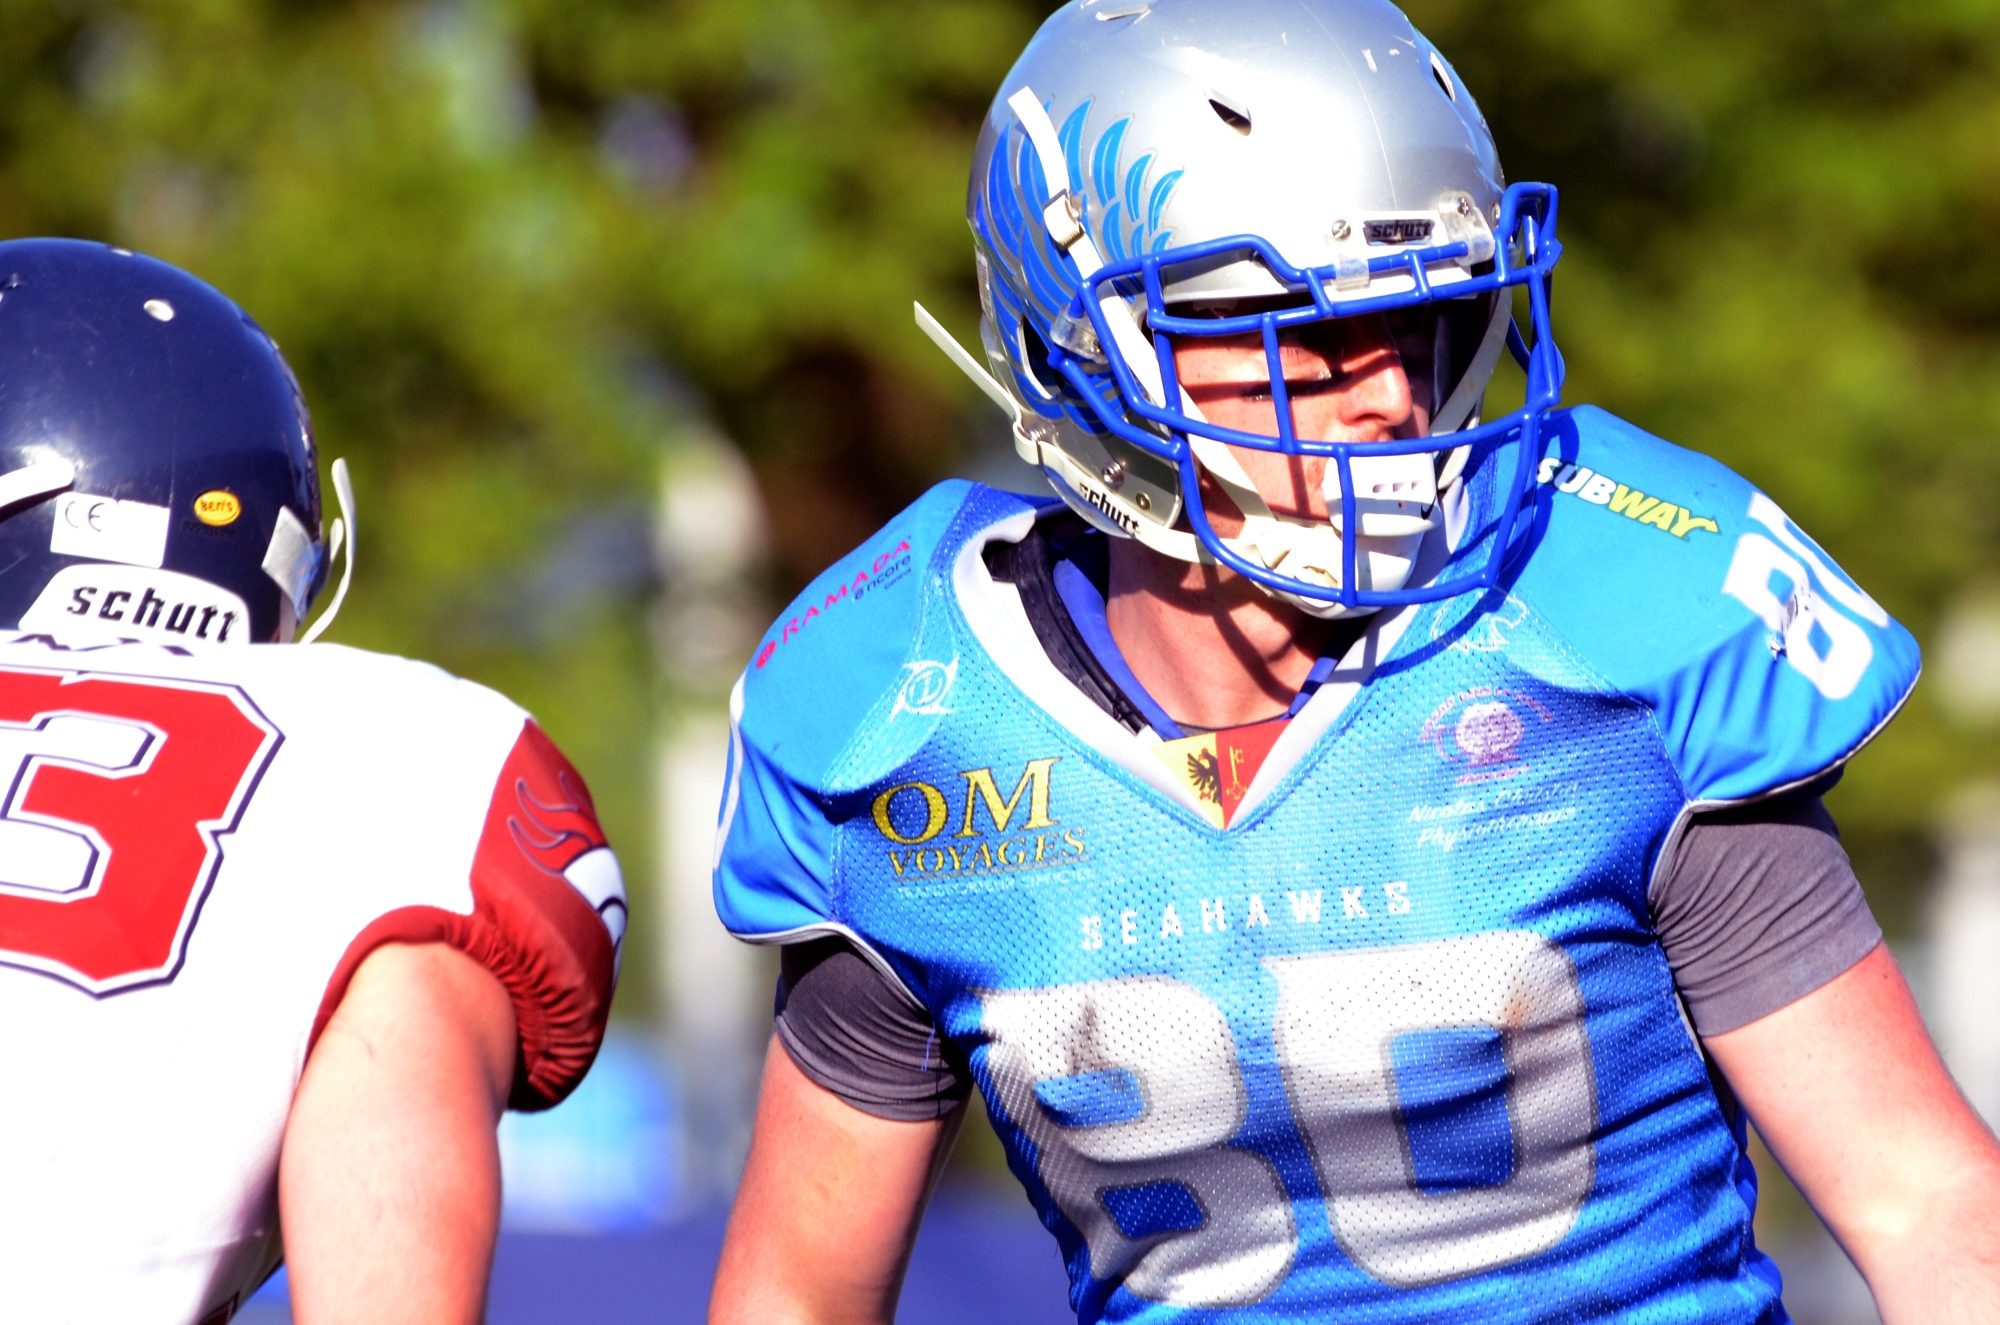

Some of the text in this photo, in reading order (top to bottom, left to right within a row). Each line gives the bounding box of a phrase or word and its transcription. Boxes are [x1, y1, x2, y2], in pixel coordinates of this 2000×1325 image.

[1370, 220, 1432, 240] schutt
[1537, 457, 1719, 540] SUBWAY
[66, 586, 238, 644] schutt
[782, 539, 911, 645] RAMADA
[870, 756, 1063, 845] OM
[887, 828, 1087, 876] VOYAGES
[1080, 881, 1412, 951] SEAHAWKS
[975, 930, 1600, 1309] 80
